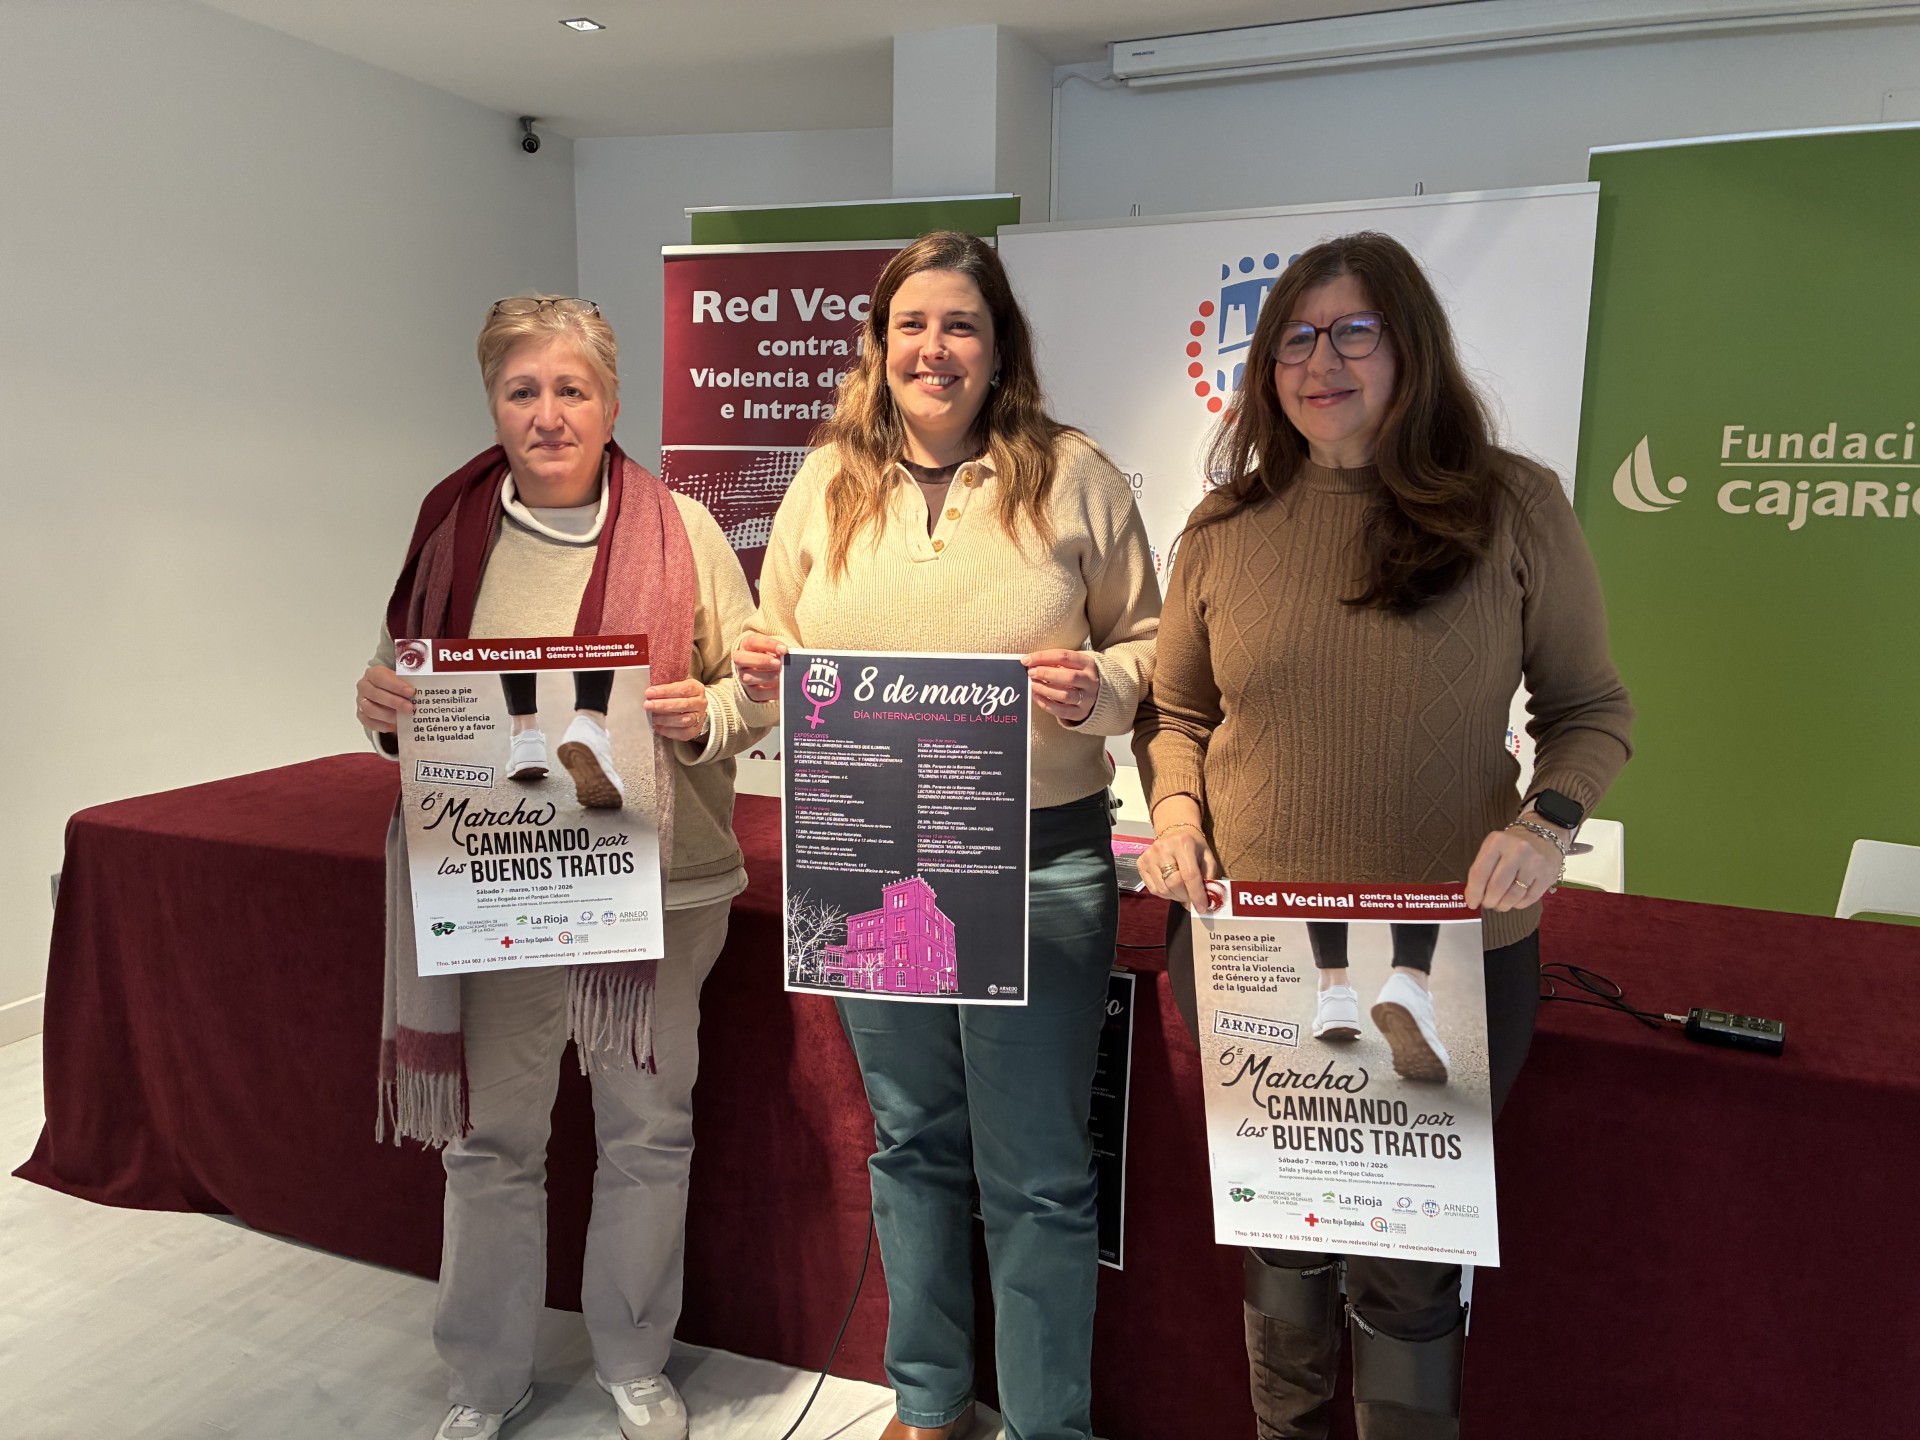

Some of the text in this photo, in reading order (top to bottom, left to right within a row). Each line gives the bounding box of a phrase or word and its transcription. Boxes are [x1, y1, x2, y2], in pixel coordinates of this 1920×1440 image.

[692, 287, 871, 323] Red Vec
[757, 335, 848, 356] contra
[689, 367, 809, 388] Violencia
[720, 399, 835, 419] e Intrafa
[1720, 421, 1917, 460] Fundaci
[584, 643, 621, 651] Violencia
[438, 647, 542, 662] Red Vecinal
[546, 651, 577, 659] Género
[424, 688, 450, 697] paseo
[458, 687, 472, 696] pie
[853, 666, 1020, 717] 8 de marzo
[432, 695, 478, 704] sensibilizar
[419, 706, 466, 714] concienciar
[451, 714, 490, 722] Violencia
[853, 710, 1018, 724] DÍA INTERNACIONAL DE LA MUJER
[413, 725, 425, 733] de
[426, 724, 458, 733] Género
[459, 725, 465, 733] y
[472, 722, 496, 730] favor
[436, 732, 475, 743] Igualdad
[420, 764, 489, 784] ARNEDO
[422, 797, 557, 848] Marcha
[465, 827, 630, 857] CAMINANDO por
[436, 851, 635, 884] los BUENOS TRATOS
[1238, 891, 1354, 908] Red Vecinal
[1404, 893, 1450, 902] Violencia
[1359, 900, 1395, 909] Género
[530, 913, 569, 925] La Rioja
[619, 910, 648, 919] ARNEDO
[1209, 932, 1222, 940] Un
[1224, 934, 1251, 944] paseo
[1260, 934, 1276, 944] pie
[1210, 943, 1282, 952] para sensibilizar
[1217, 953, 1268, 962] concienciar
[1211, 963, 1295, 973] contra la Violencia
[1212, 973, 1223, 981] de
[1225, 973, 1260, 982] Género
[1261, 976, 1267, 984] y
[1276, 974, 1301, 983] favor
[1212, 983, 1278, 994] de la Igualdad
[1219, 1017, 1293, 1039] ARNEDO
[1218, 1045, 1369, 1109] 6ª Marcha
[1267, 1093, 1456, 1132] CAMINANDO por
[1235, 1117, 1462, 1160] los BUENOS TRATOS
[1278, 1156, 1304, 1164] Sábado
[1314, 1159, 1338, 1167] marzo,
[1301, 1167, 1322, 1176] llegada
[1339, 1170, 1360, 1178] Parque
[1338, 1194, 1383, 1208] La Rioja
[1443, 1203, 1479, 1214] ARNEDO
